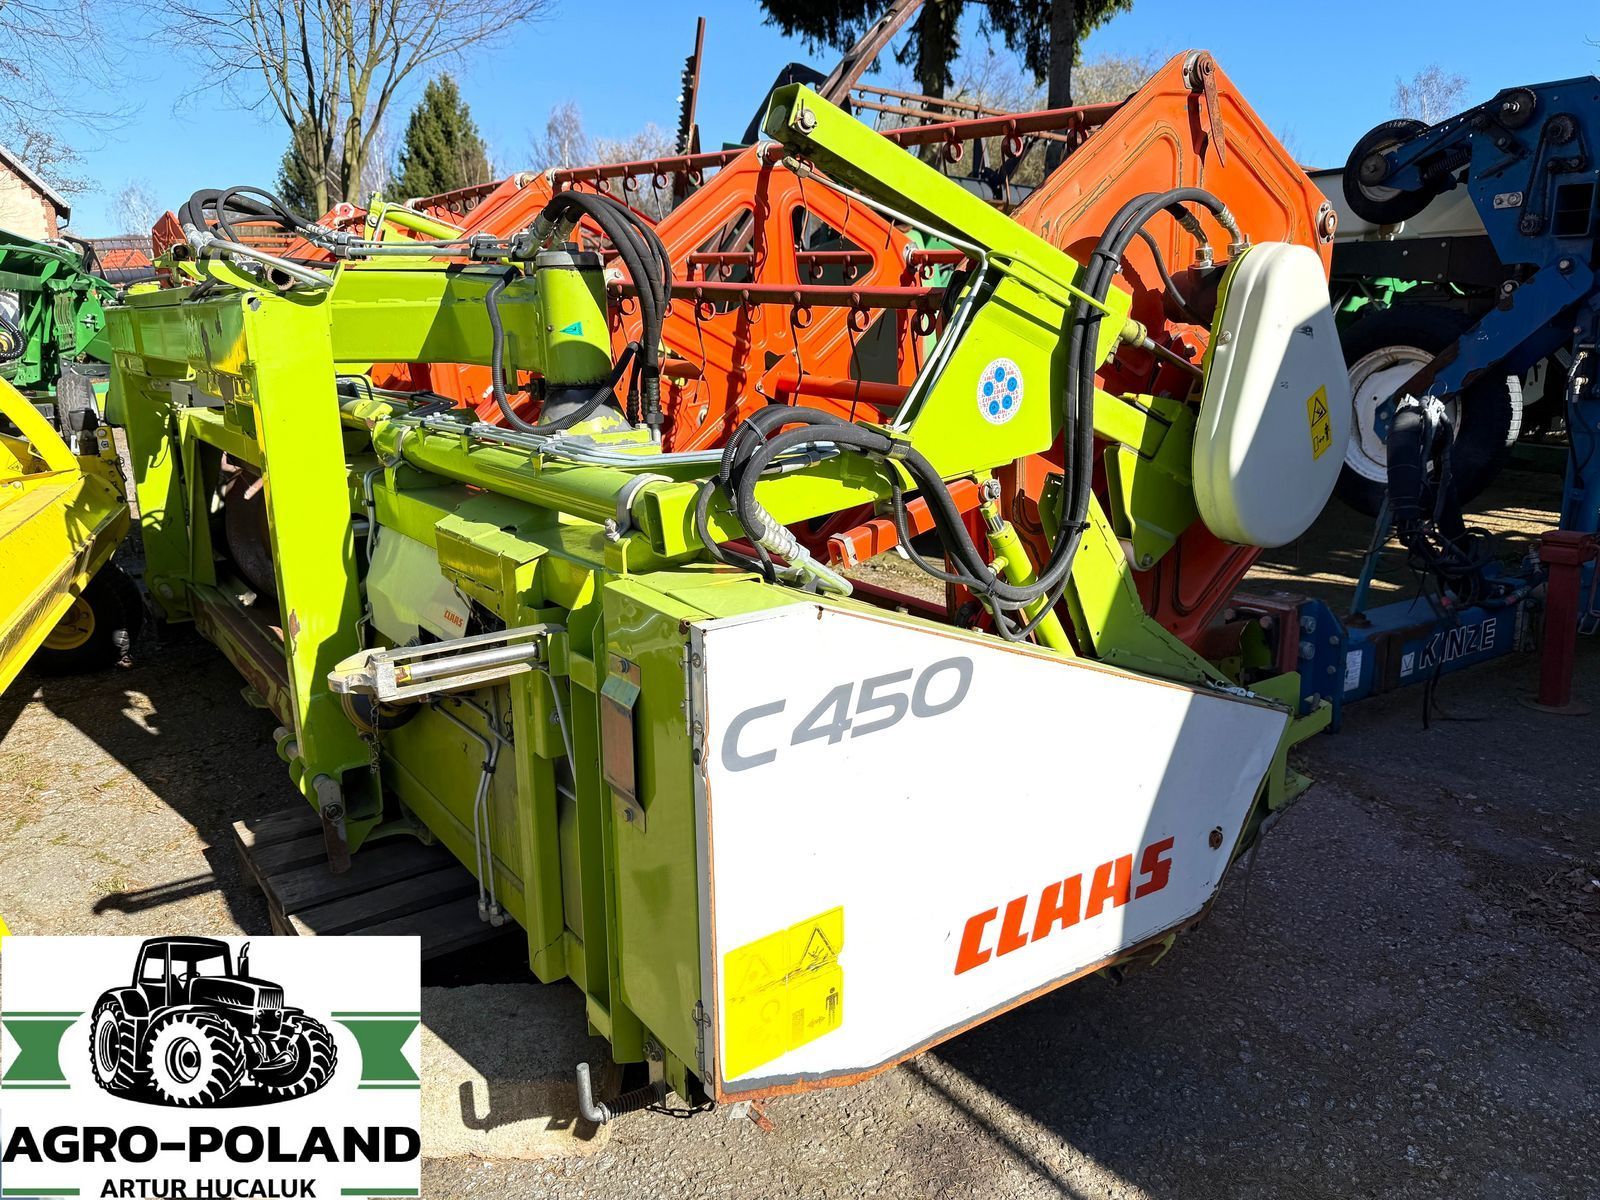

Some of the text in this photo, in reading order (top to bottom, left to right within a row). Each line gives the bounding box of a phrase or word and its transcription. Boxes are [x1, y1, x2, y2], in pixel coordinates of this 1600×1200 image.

[444, 610, 463, 627] CLAAS
[721, 656, 974, 773] C 450
[954, 837, 1174, 975] CLAAS
